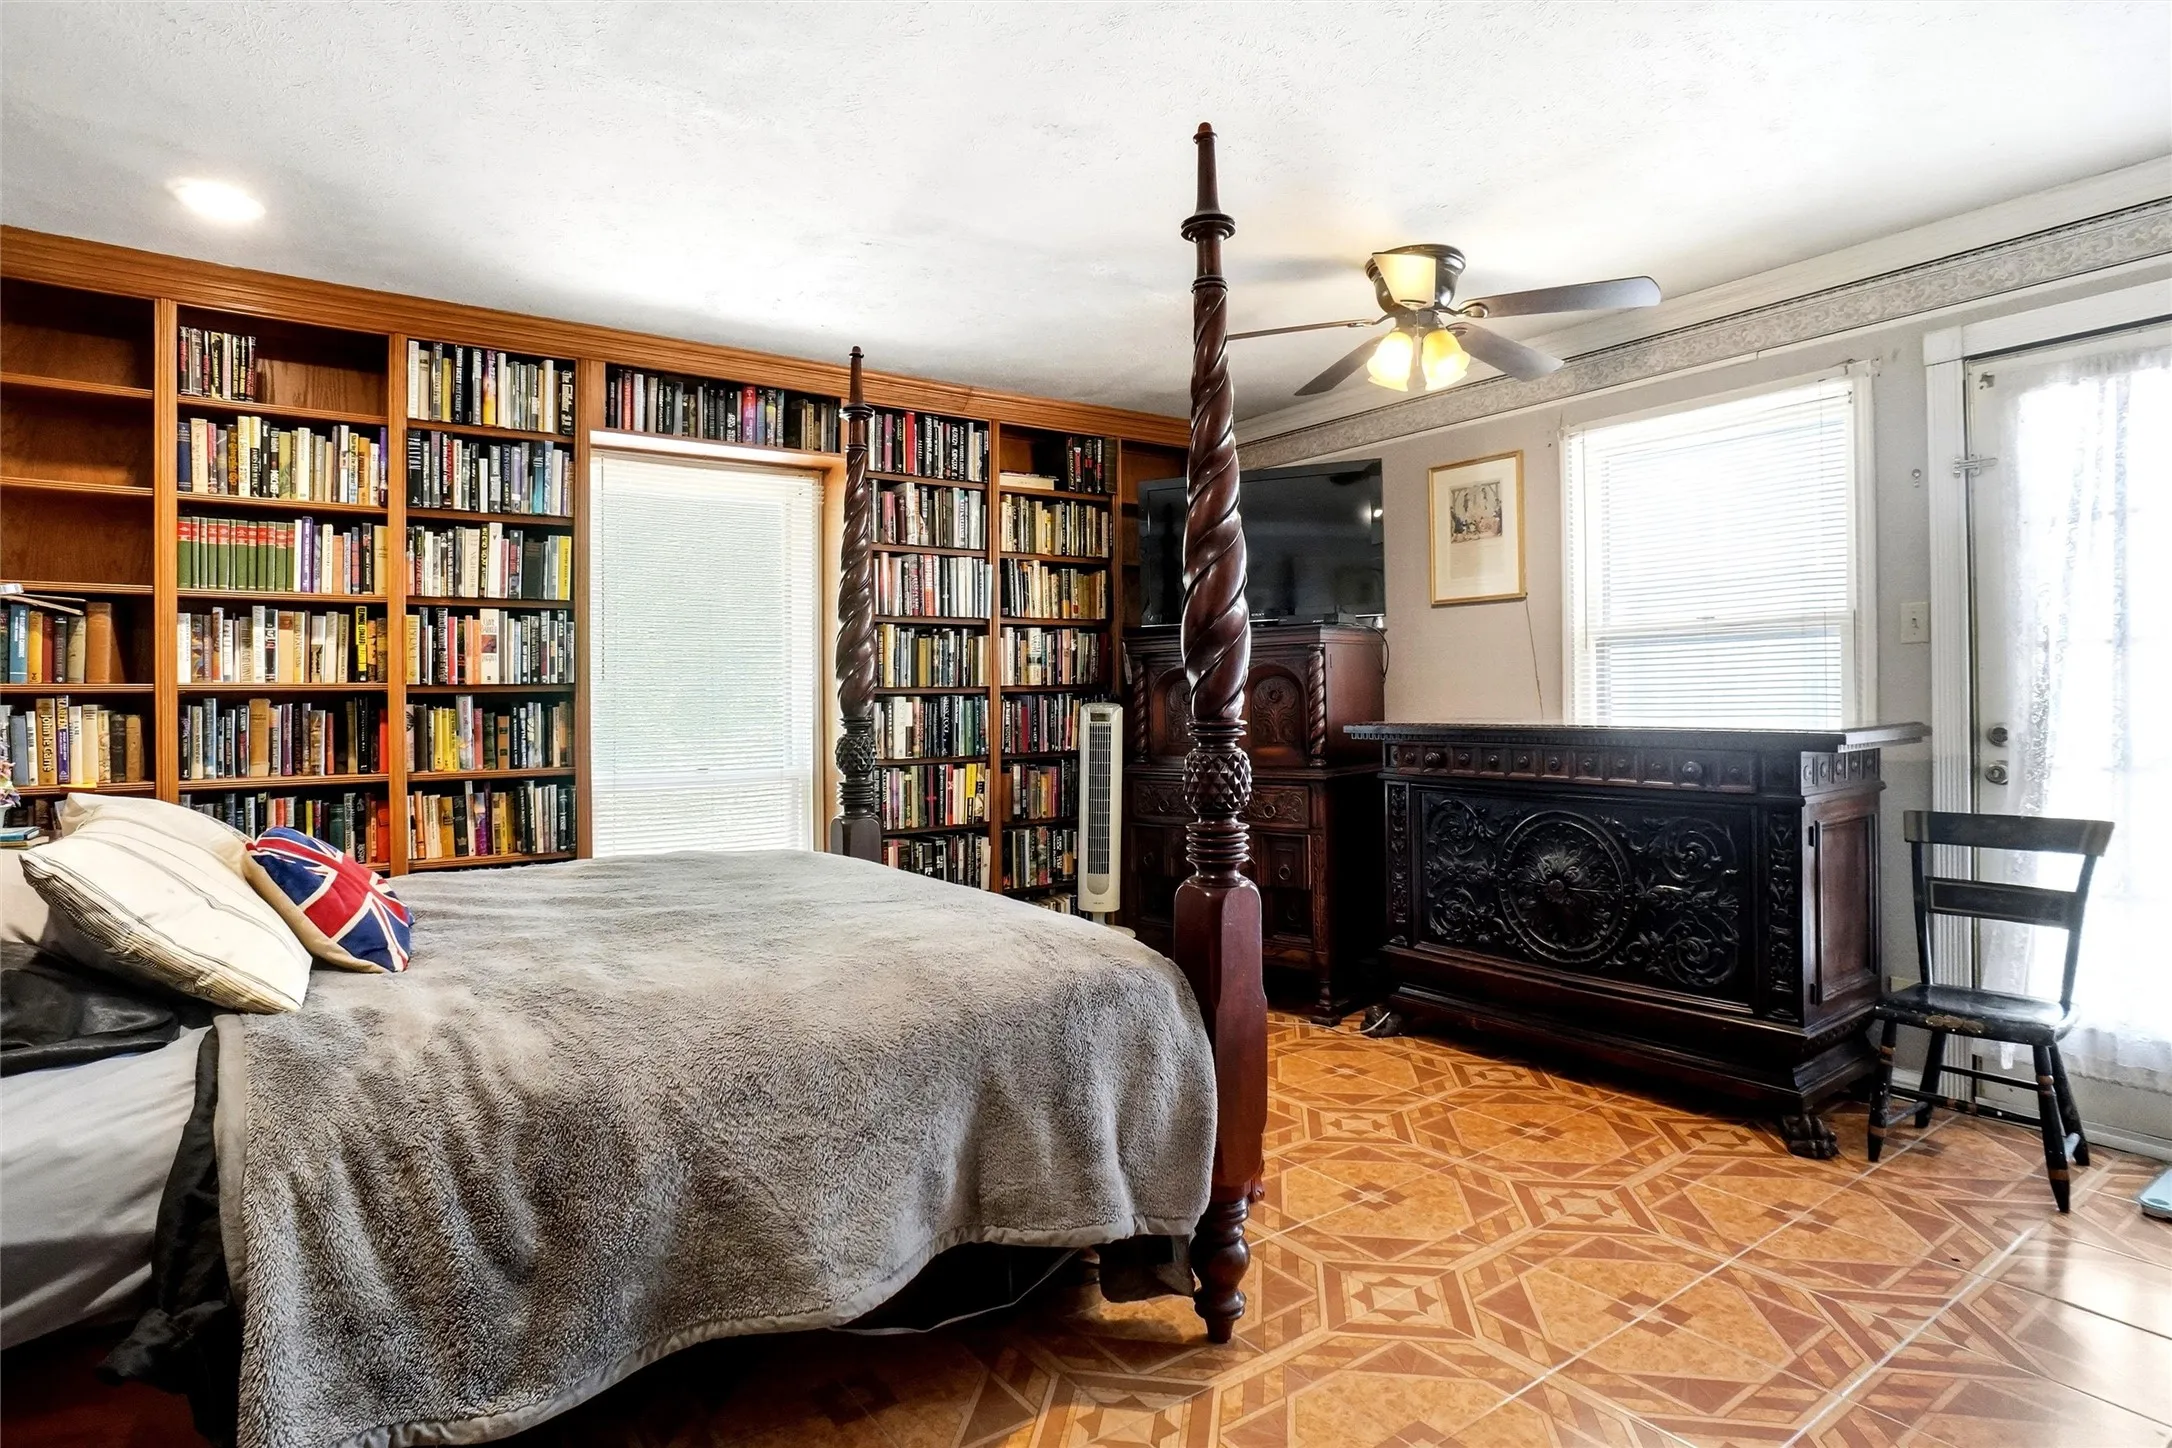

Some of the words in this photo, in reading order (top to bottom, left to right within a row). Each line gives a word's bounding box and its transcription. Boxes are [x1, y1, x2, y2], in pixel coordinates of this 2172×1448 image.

[40, 714, 53, 735] John
[57, 697, 68, 730] KAREEM
[43, 747, 54, 772] Carré
